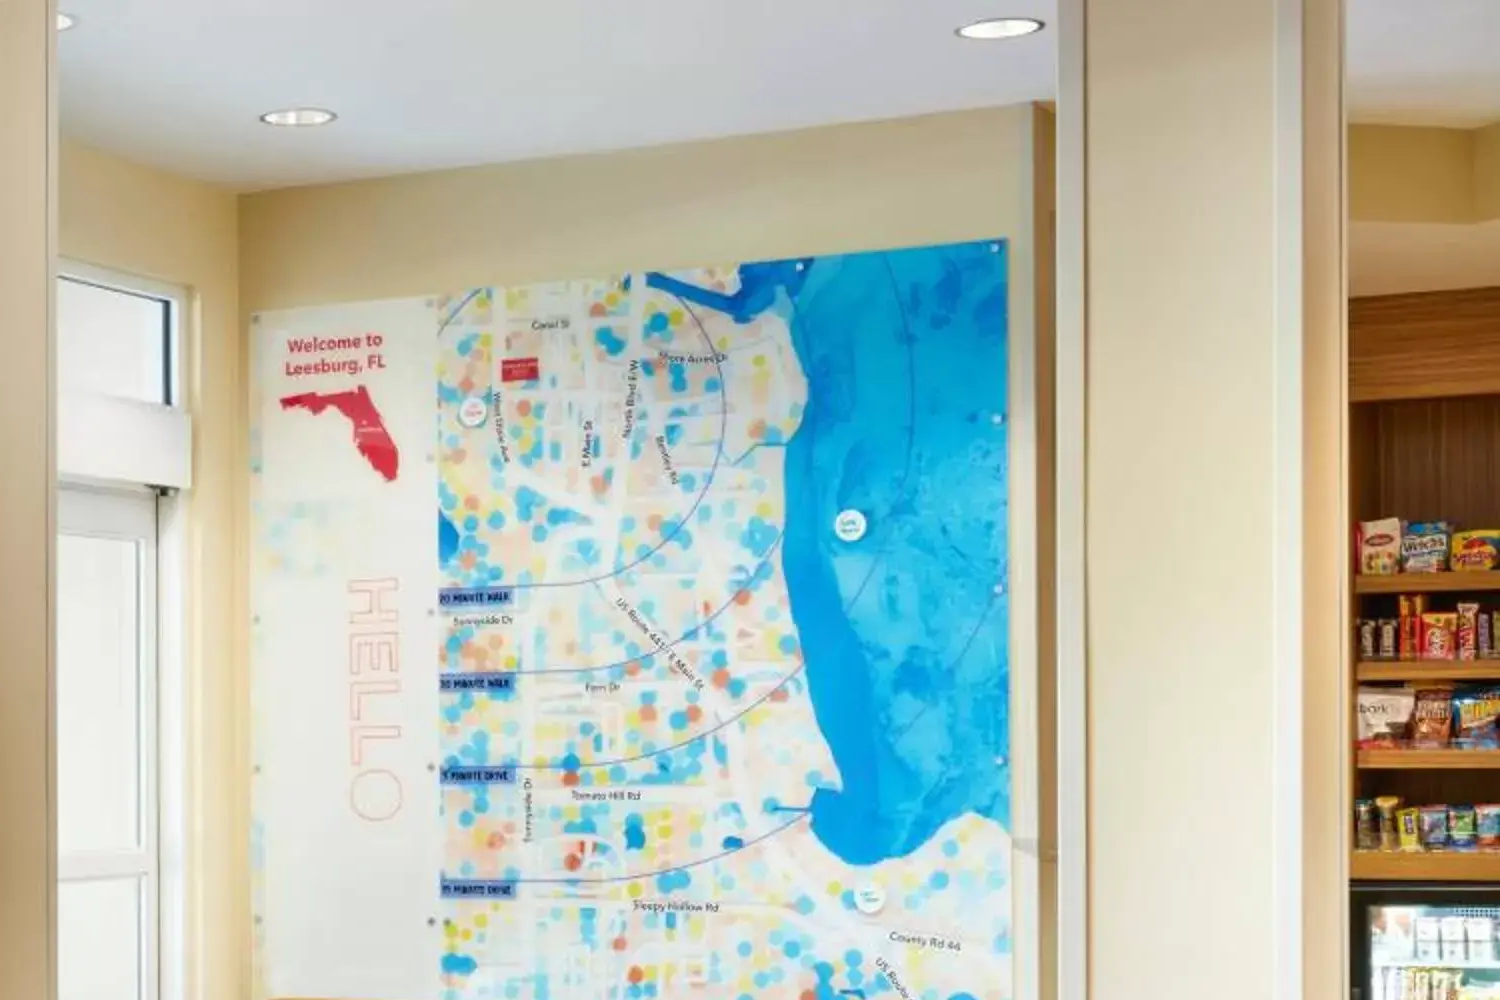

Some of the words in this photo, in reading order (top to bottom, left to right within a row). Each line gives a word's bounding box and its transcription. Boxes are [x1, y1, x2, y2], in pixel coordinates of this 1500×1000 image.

[287, 336, 361, 353] Welcome
[366, 334, 383, 347] to
[285, 358, 363, 376] Leesburg,
[367, 354, 386, 369] FL
[348, 577, 402, 822] HELLO
[627, 790, 642, 800] Rd
[889, 931, 927, 948] County
[929, 937, 945, 949] Rd
